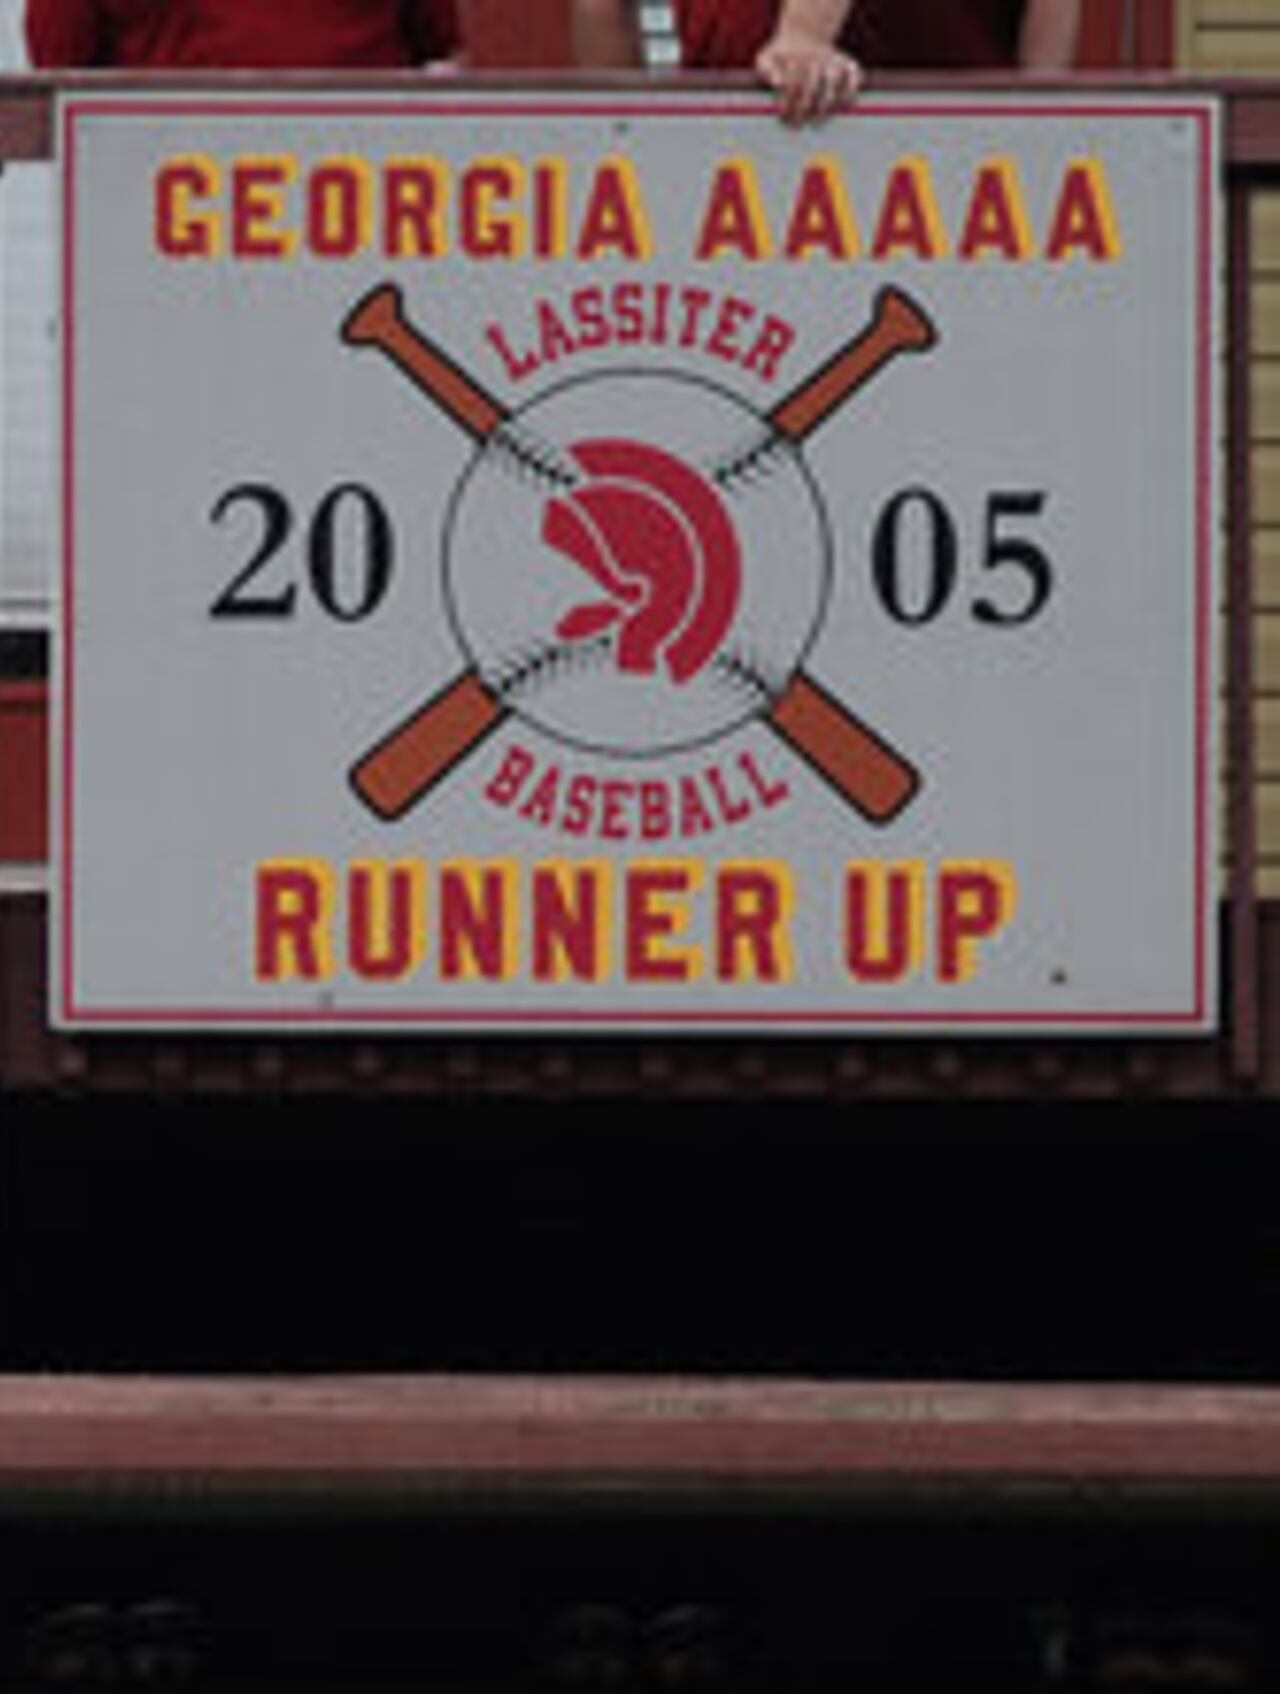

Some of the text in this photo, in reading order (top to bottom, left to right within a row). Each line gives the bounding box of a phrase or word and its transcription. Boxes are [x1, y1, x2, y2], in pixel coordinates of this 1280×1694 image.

[154, 154, 1121, 262] GEORGIA AAAAA
[485, 282, 795, 383] LASSITER
[208, 482, 1054, 629] 20 05
[484, 746, 790, 840] BASEBALL
[255, 857, 1018, 984] RUNNER UP
